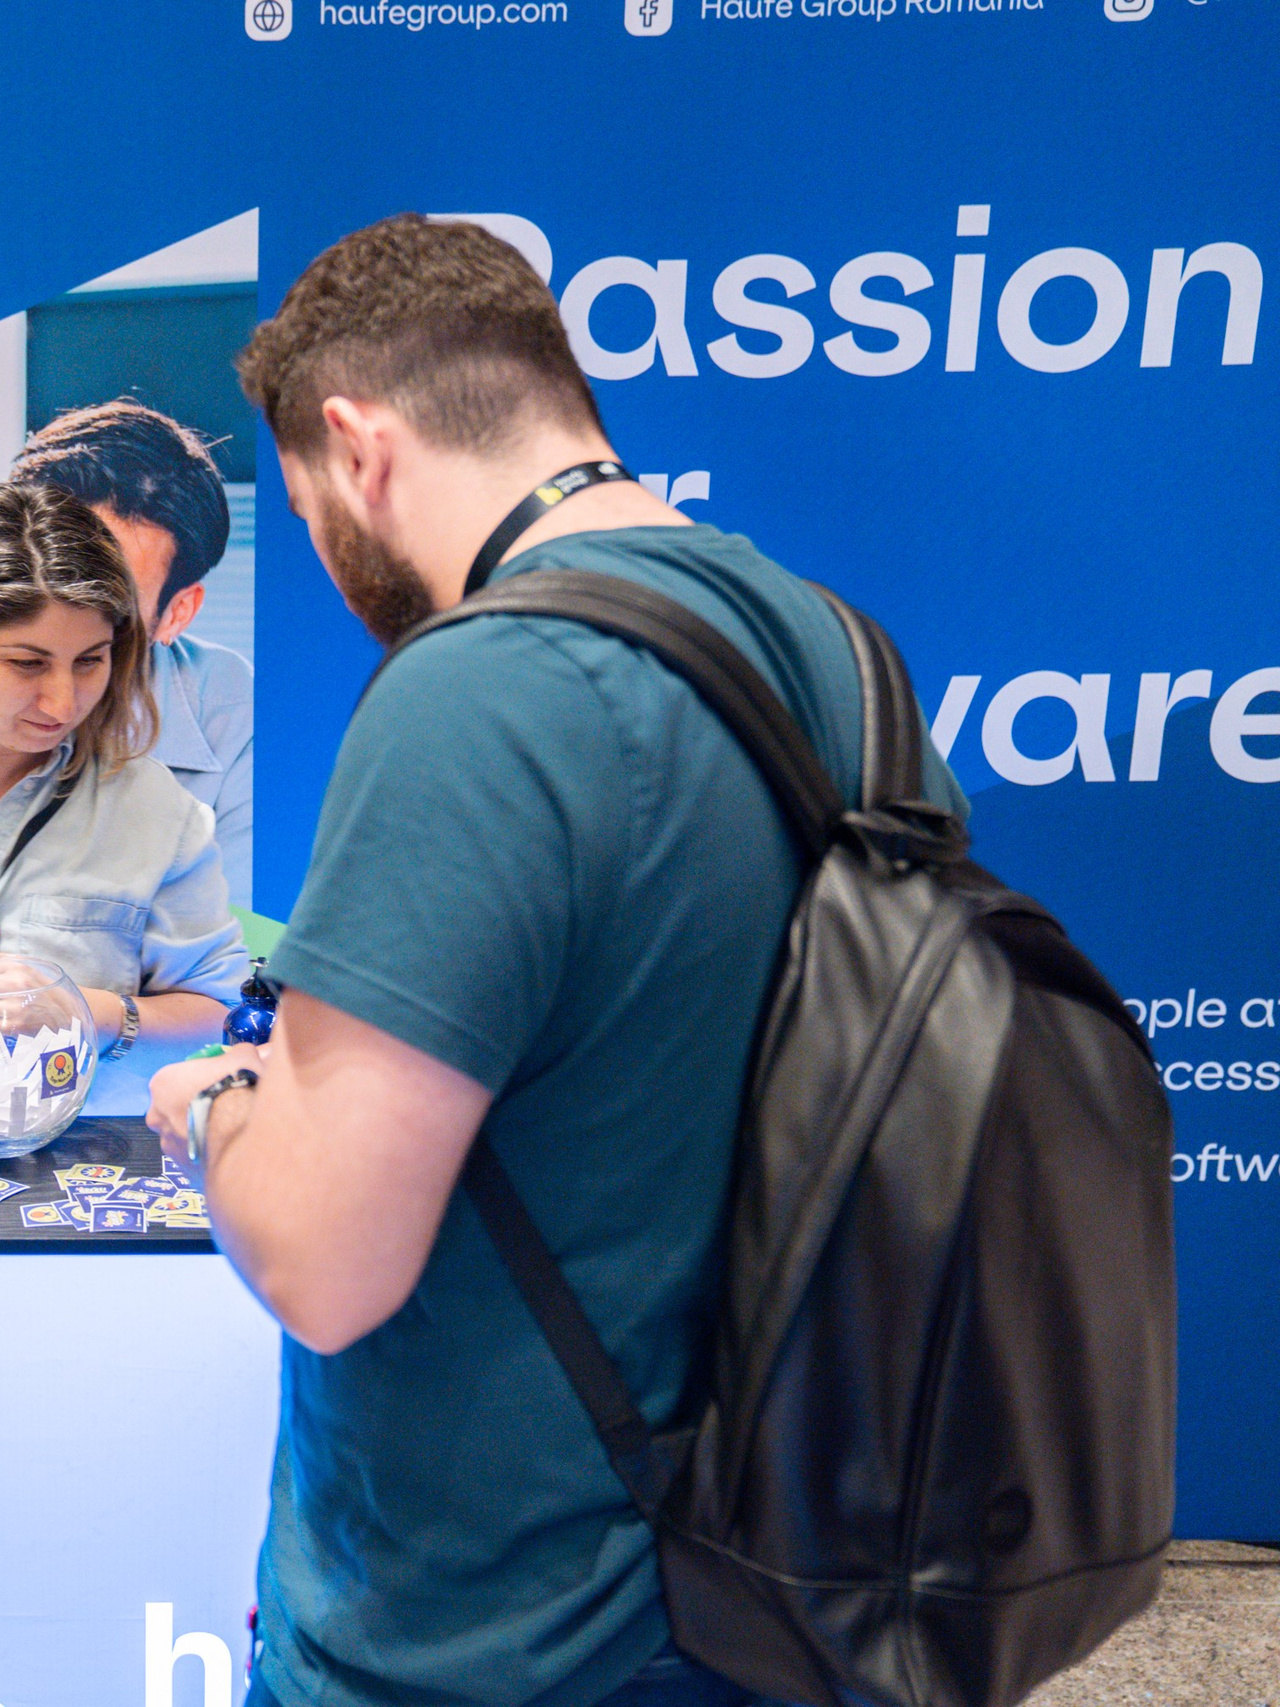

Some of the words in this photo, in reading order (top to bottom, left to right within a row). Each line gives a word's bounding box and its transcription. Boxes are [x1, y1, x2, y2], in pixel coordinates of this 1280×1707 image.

[321, 0, 567, 32] haufegroup.com
[701, 0, 793, 19] Haufe
[801, 0, 897, 22] Group
[930, 666, 1280, 786] are
[1154, 1061, 1280, 1091] cess
[1170, 1143, 1280, 1182] oftw
